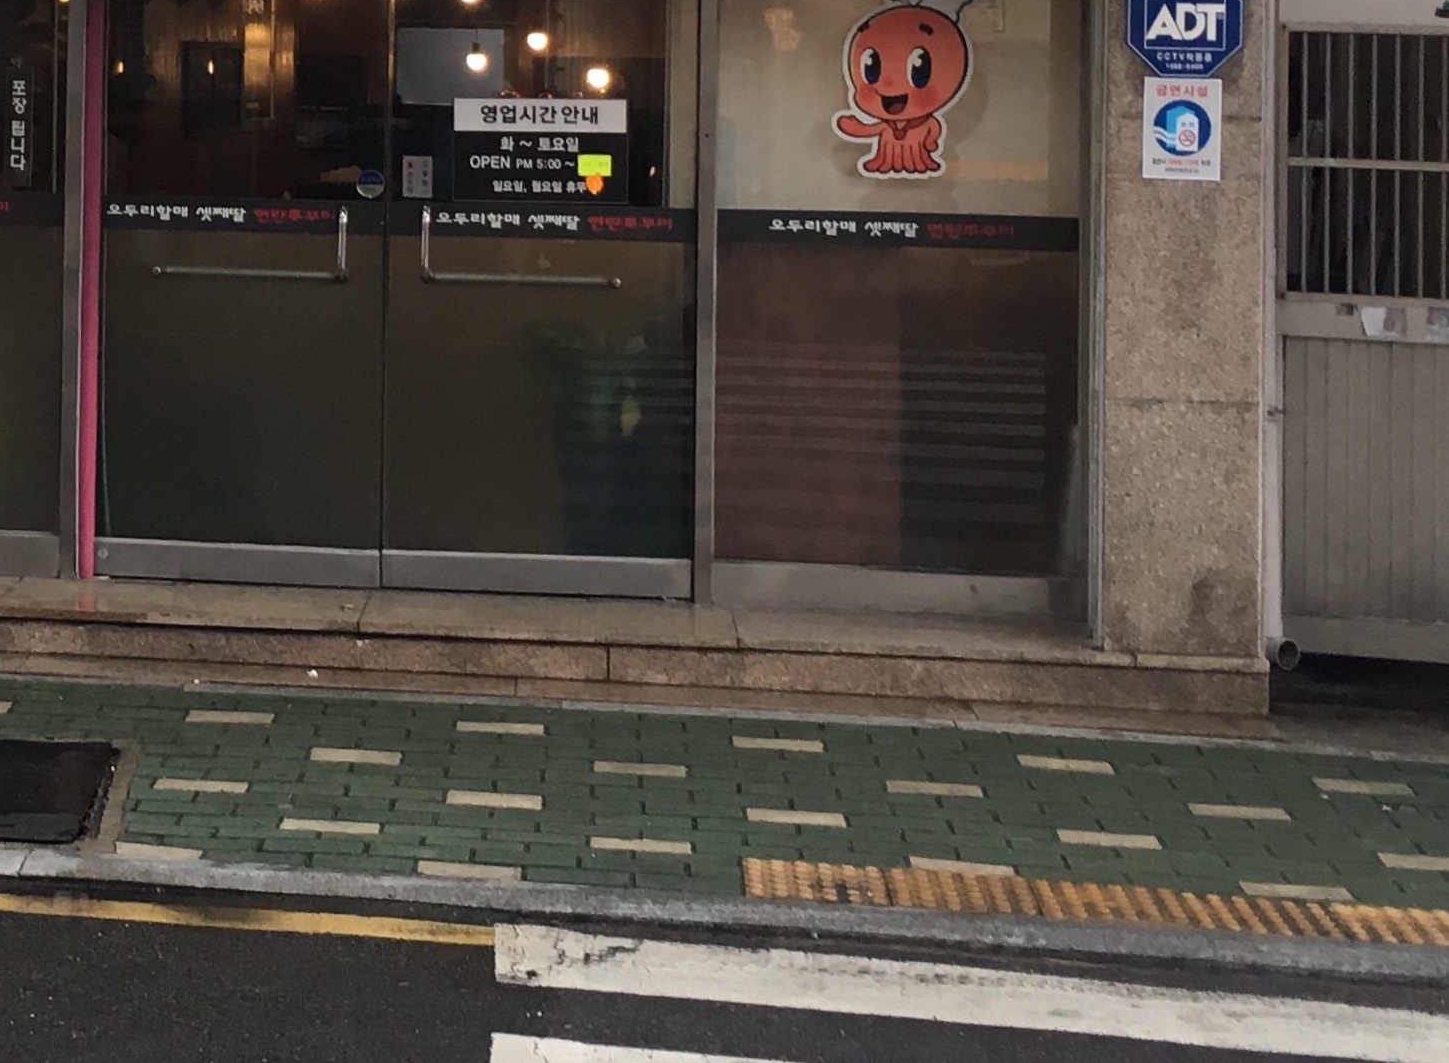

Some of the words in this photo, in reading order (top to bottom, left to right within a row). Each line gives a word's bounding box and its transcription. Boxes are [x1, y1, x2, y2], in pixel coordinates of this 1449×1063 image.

[1145, 2, 1226, 42] ADT
[12, 80, 27, 115] 포장
[500, 136, 514, 152] 화
[537, 137, 579, 152] 토요일
[469, 155, 511, 169] OPEN
[515, 158, 533, 169] PM
[536, 158, 562, 169] 5:00
[531, 180, 563, 193] 월요일
[106, 203, 189, 221] 오두리할매
[195, 205, 247, 223] 셋째딸
[435, 211, 521, 229] 오두리할매
[527, 213, 581, 231] 셋째딸
[768, 218, 857, 236] 오두리할매
[864, 220, 919, 238] 셋째딸
